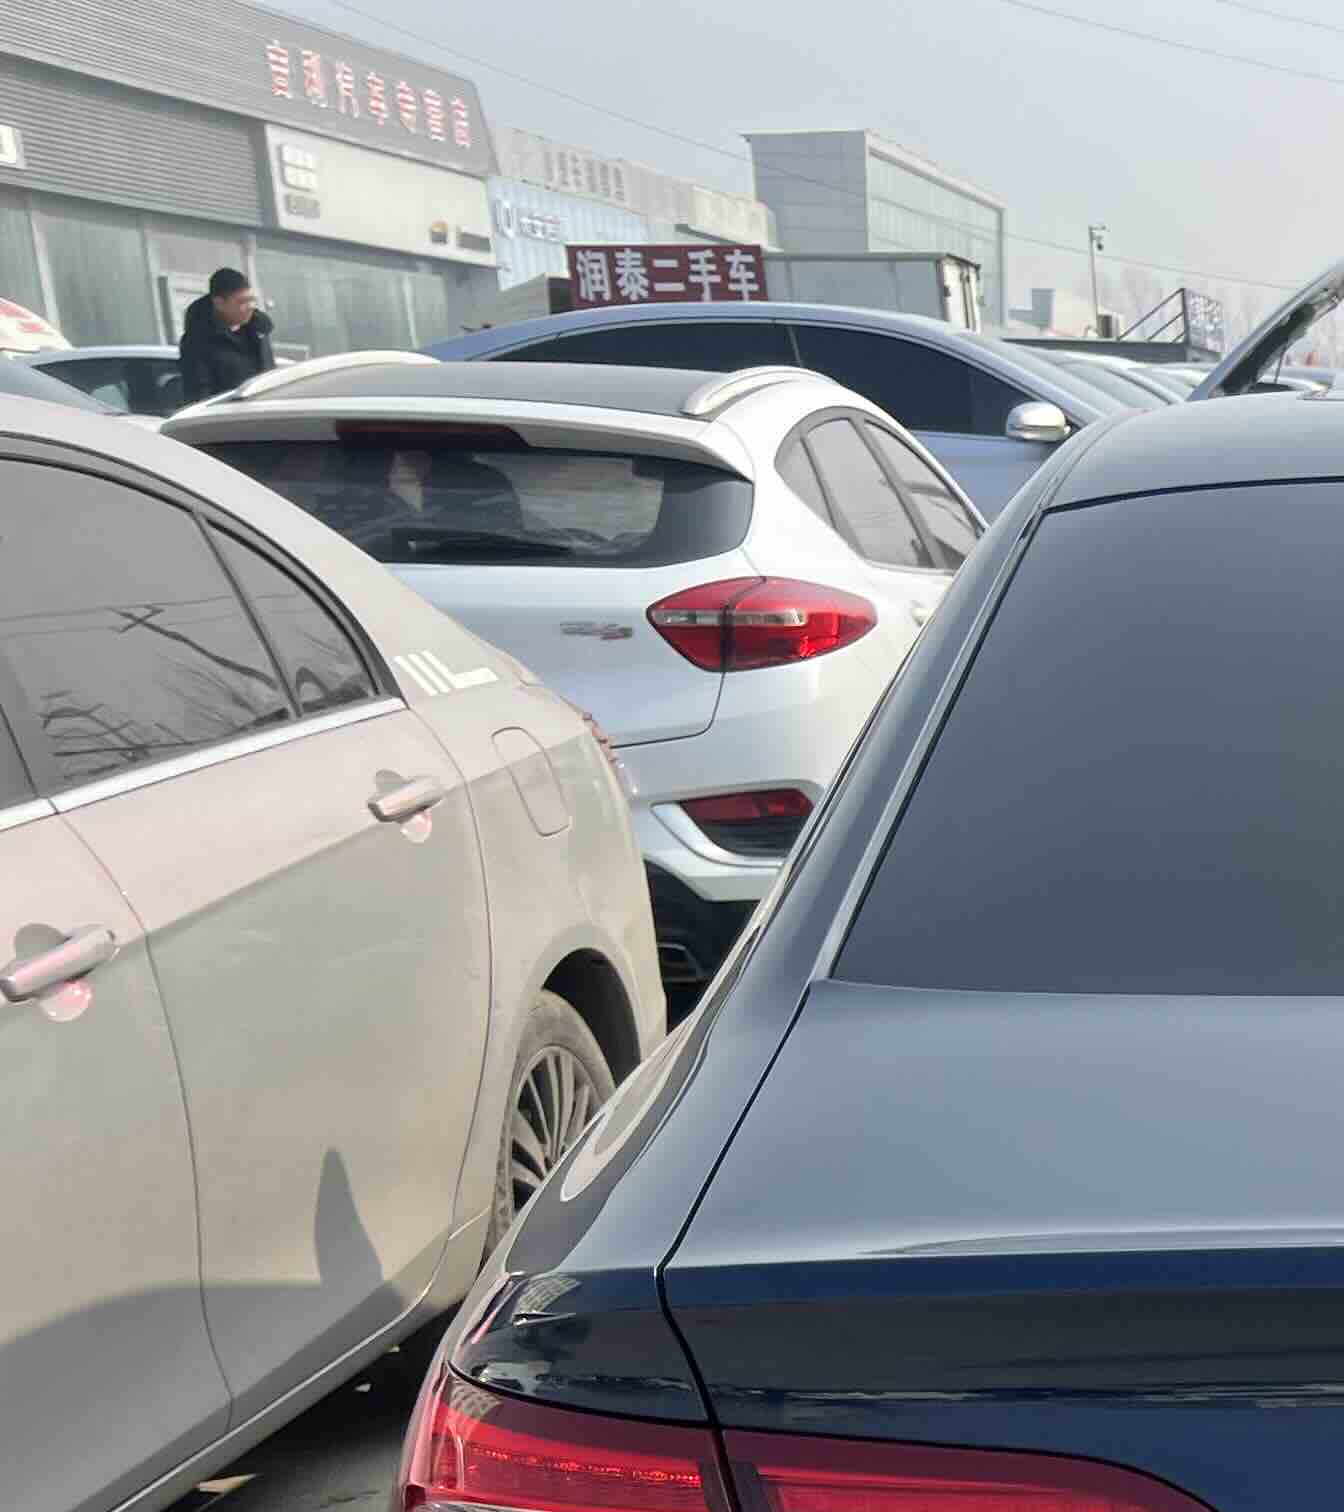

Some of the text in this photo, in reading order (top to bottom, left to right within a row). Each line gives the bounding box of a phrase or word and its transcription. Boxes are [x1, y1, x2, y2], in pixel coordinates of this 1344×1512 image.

[575, 248, 760, 303] 润泰二手车
